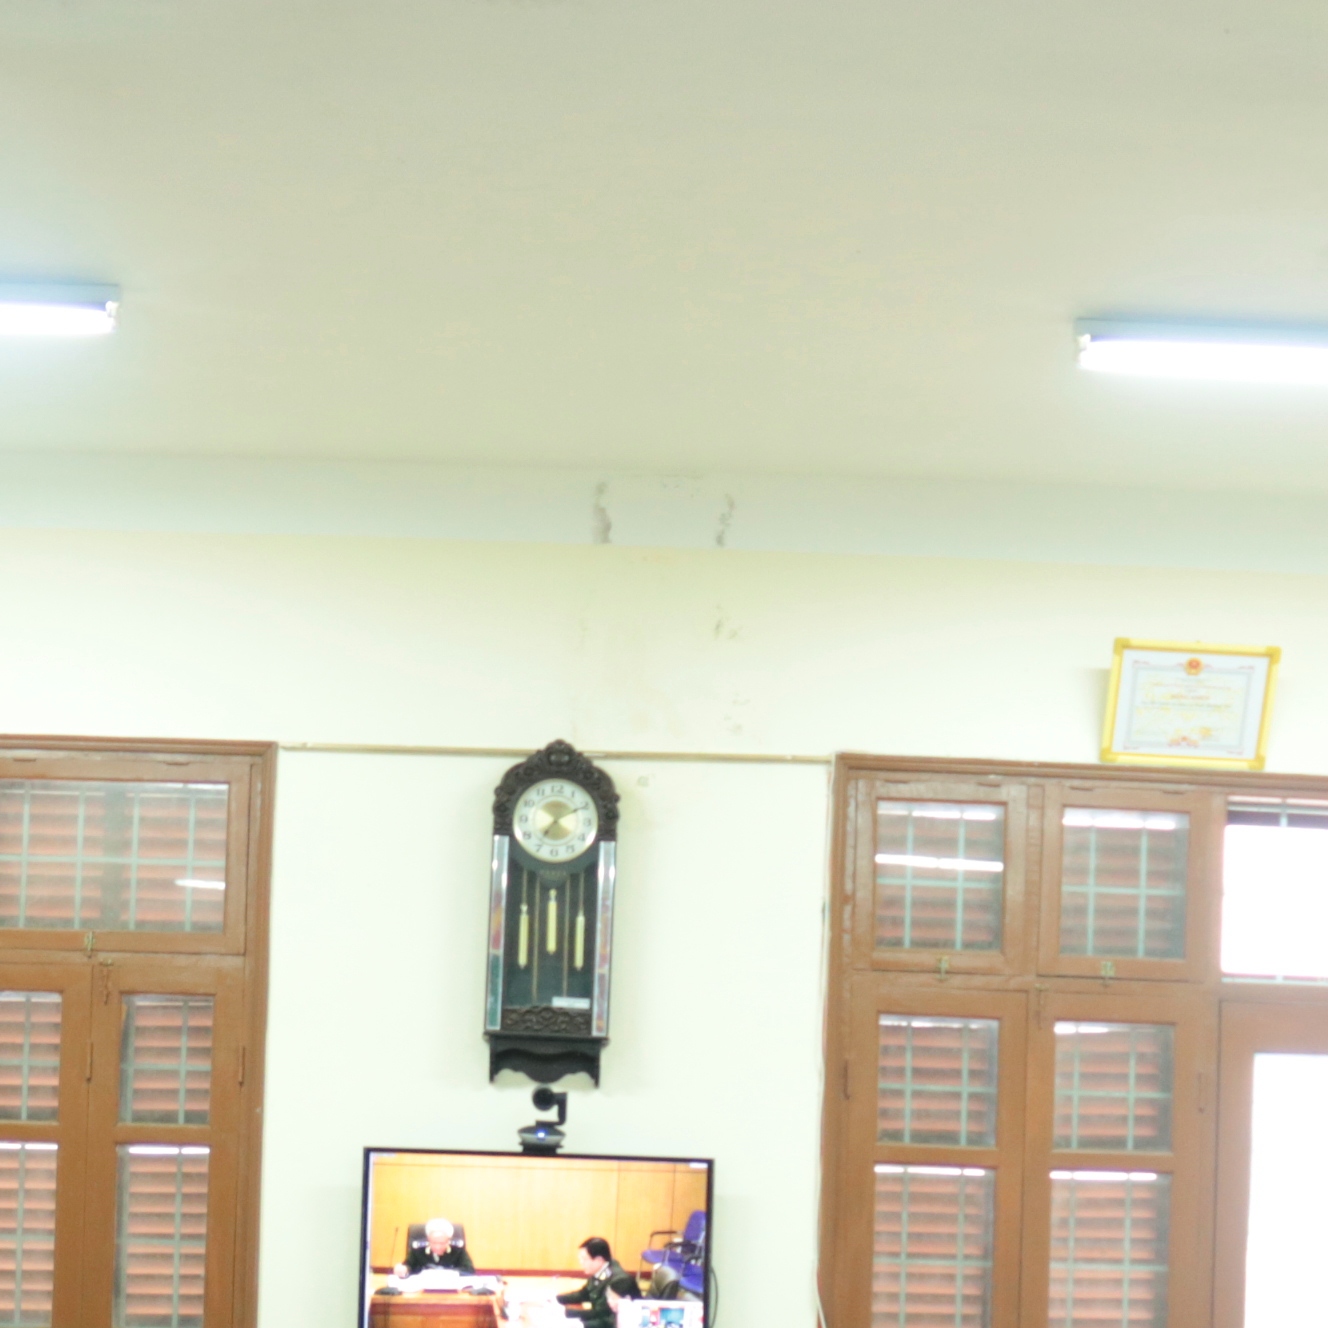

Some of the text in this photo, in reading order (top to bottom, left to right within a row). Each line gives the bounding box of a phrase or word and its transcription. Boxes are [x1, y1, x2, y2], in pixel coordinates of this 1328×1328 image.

[536, 788, 545, 796] 11
[551, 785, 564, 794] 12
[523, 800, 535, 808] 10
